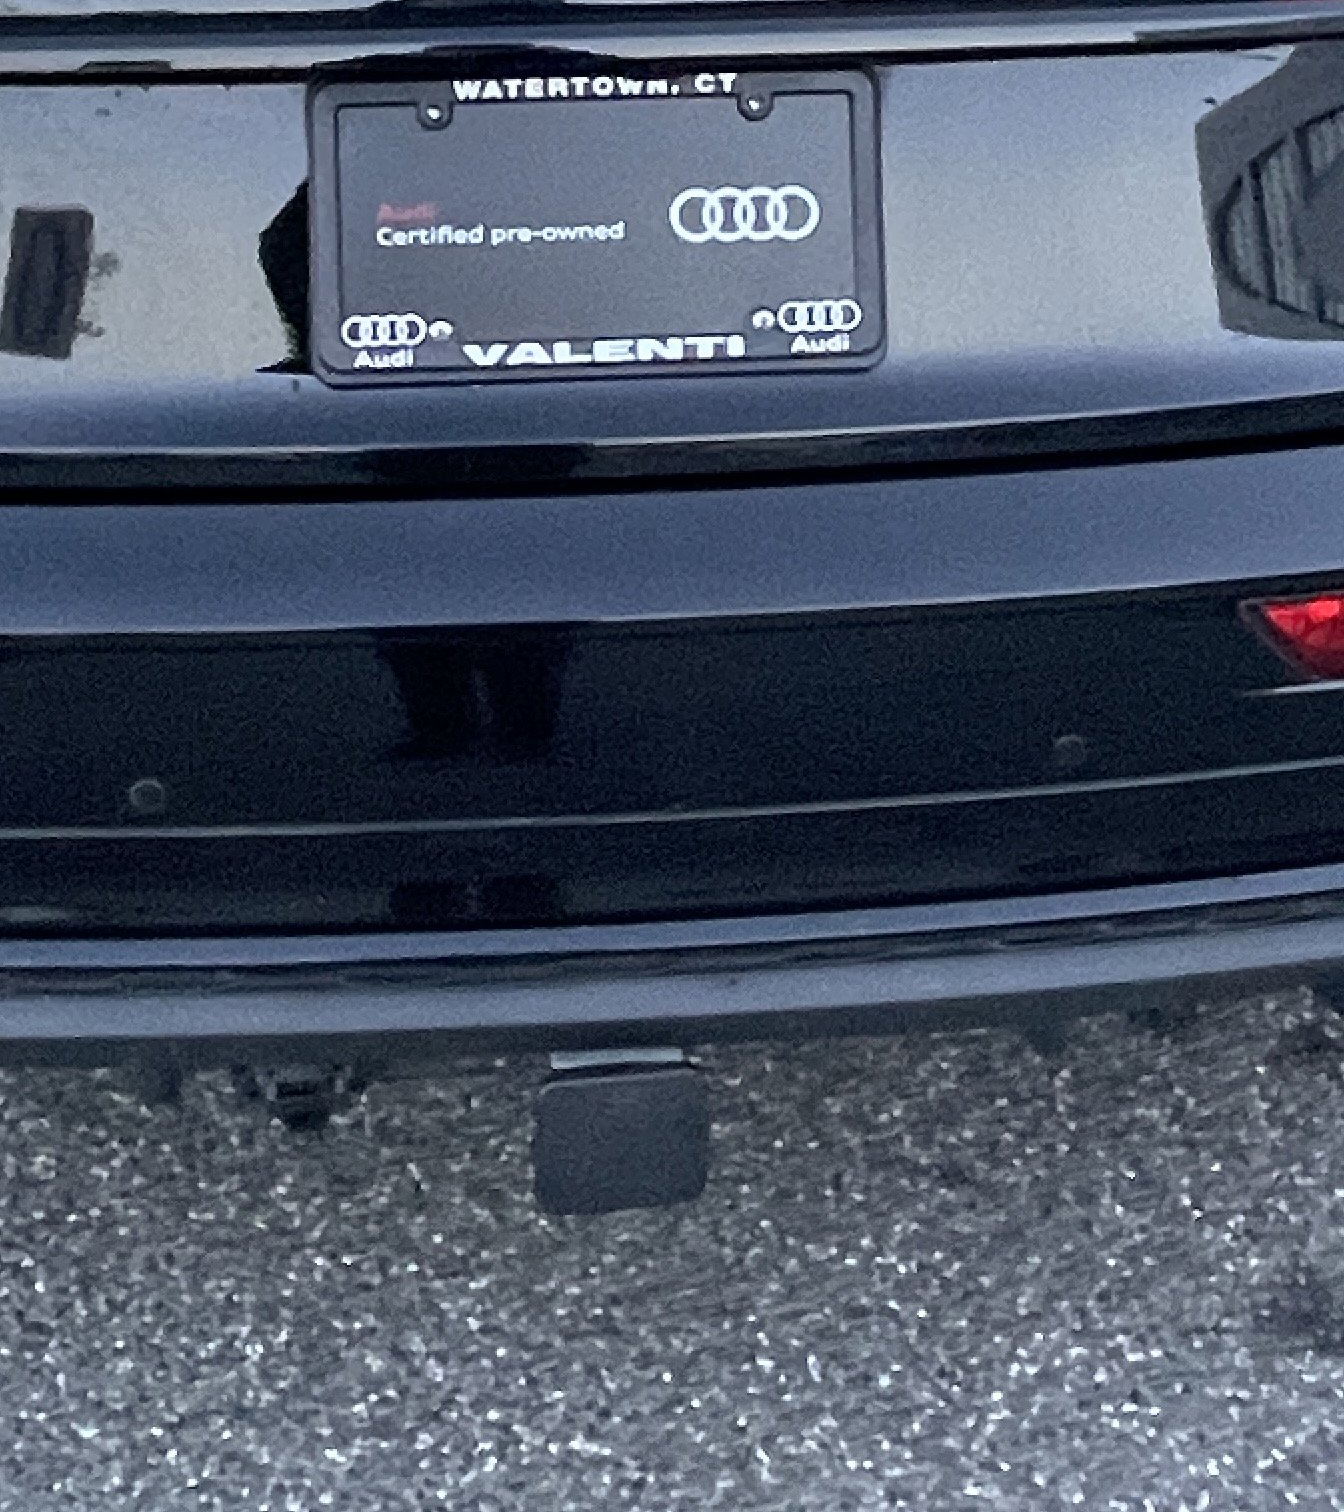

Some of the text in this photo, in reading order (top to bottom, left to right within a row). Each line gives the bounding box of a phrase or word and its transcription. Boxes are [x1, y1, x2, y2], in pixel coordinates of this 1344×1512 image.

[694, 72, 738, 94] CT
[376, 220, 626, 248] Certified pre-owned
[462, 334, 747, 367] VALENTI
[789, 331, 851, 354] Audi
[353, 348, 415, 369] Audi
